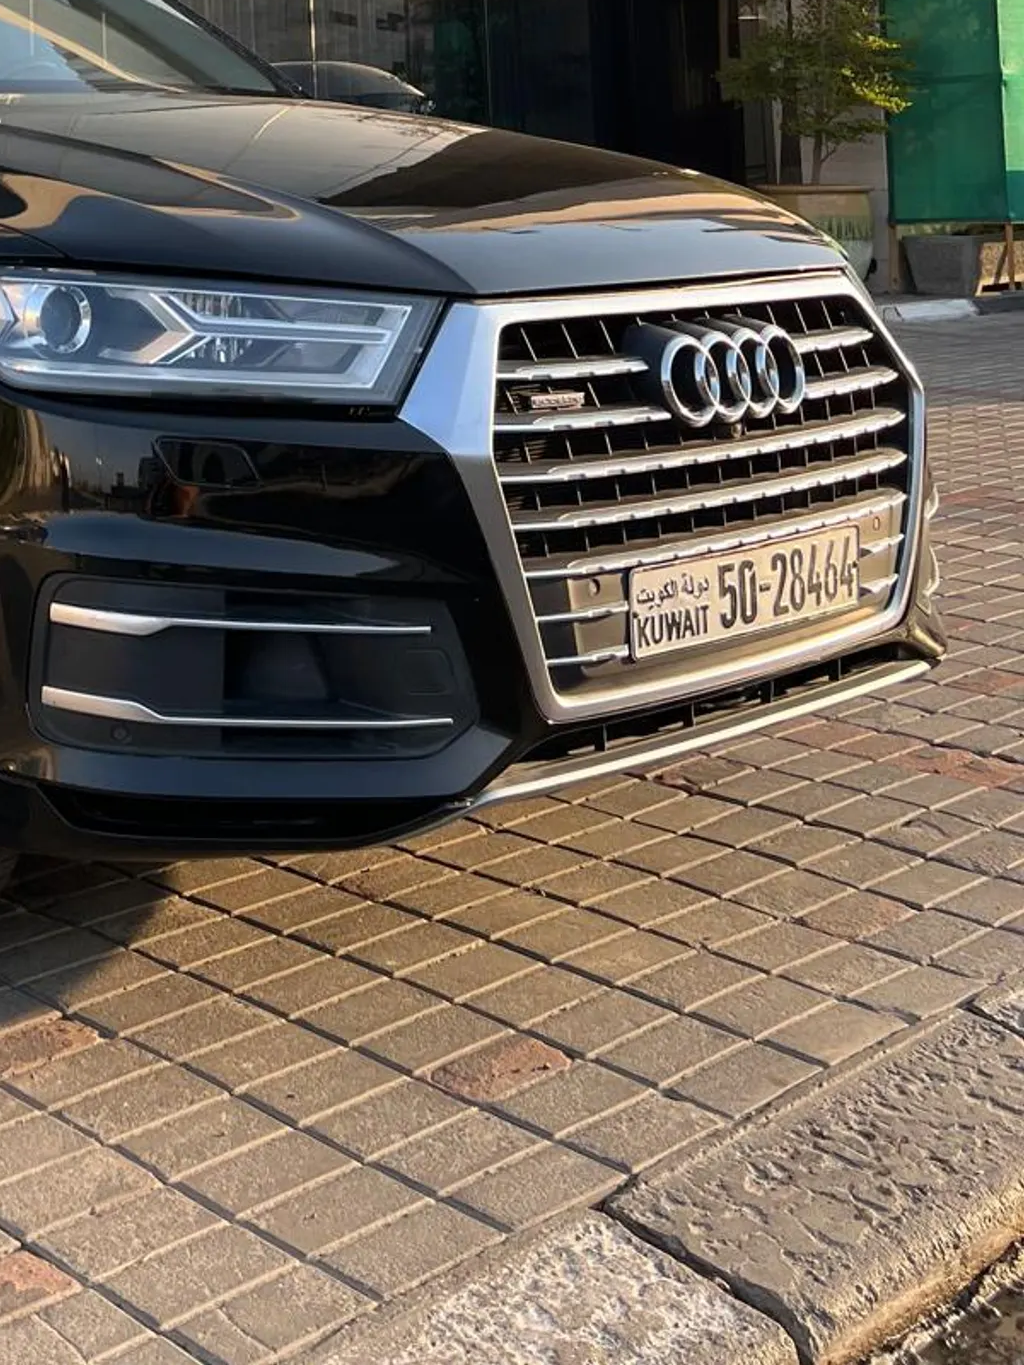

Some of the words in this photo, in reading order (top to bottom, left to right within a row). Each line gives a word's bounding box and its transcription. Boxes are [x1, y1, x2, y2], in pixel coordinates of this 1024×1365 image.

[636, 580, 679, 610] الكويت
[681, 573, 710, 599] دولة
[717, 536, 855, 628] 50-28464
[637, 605, 709, 648] KUWAIT
